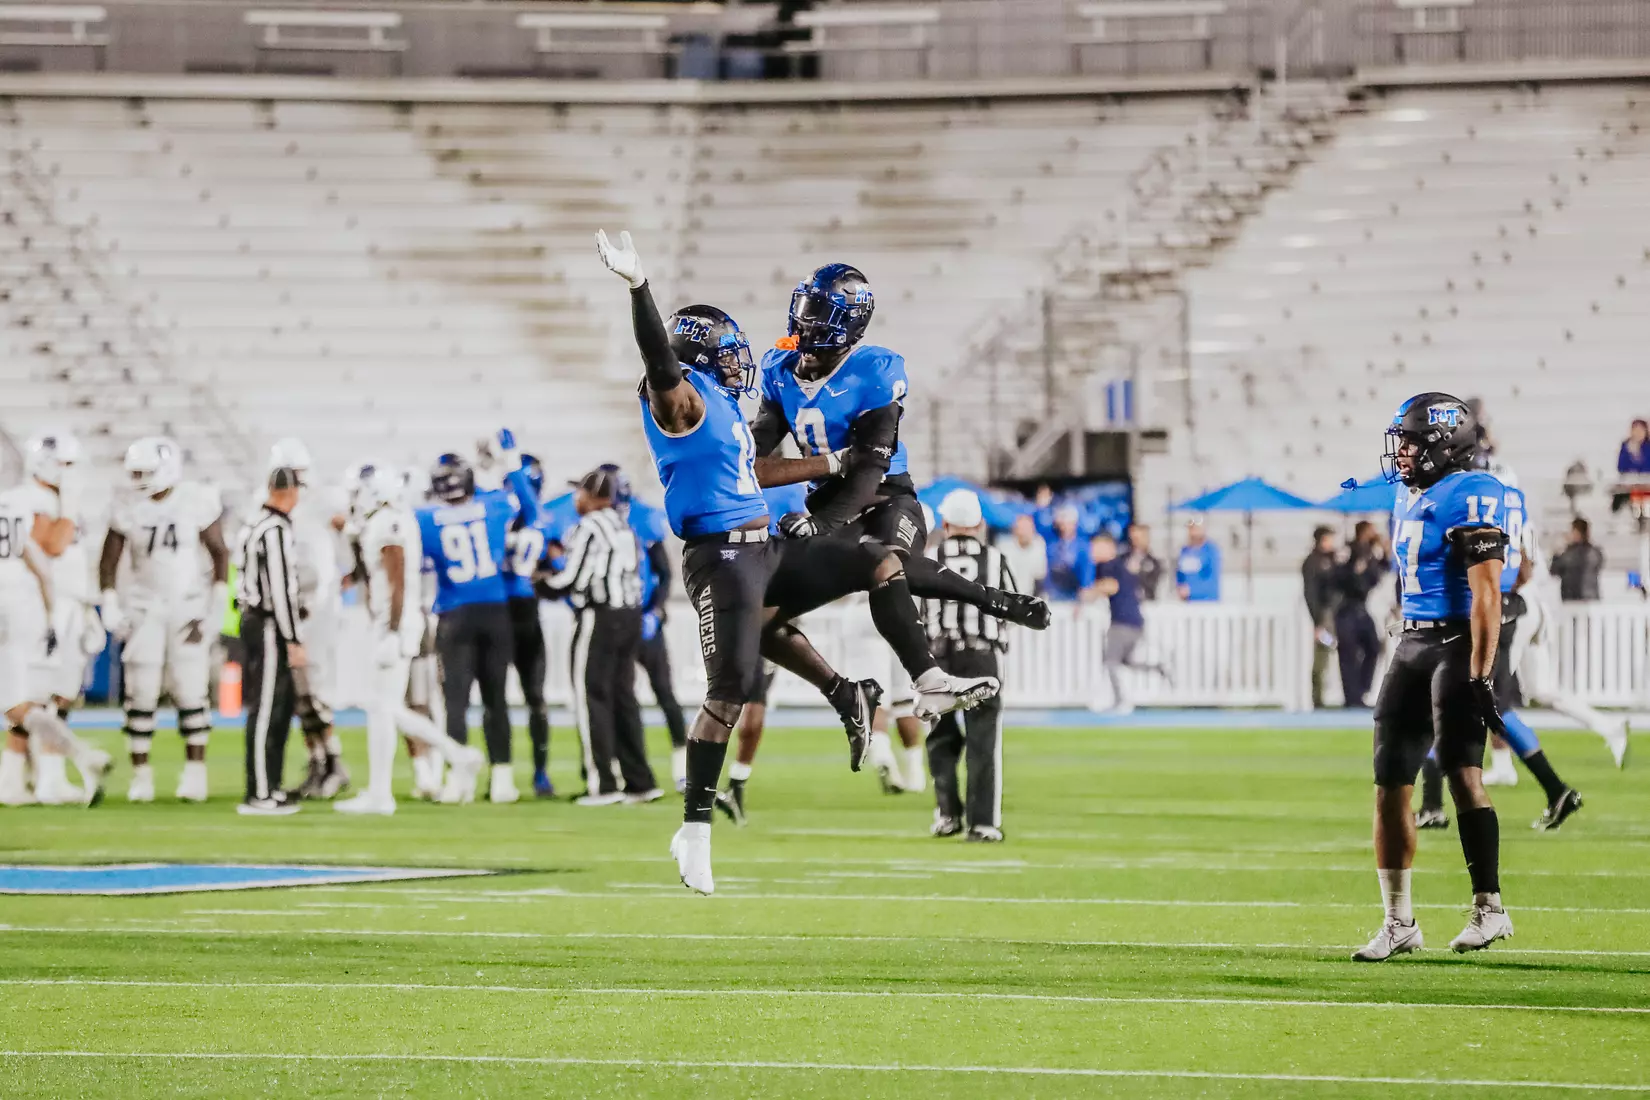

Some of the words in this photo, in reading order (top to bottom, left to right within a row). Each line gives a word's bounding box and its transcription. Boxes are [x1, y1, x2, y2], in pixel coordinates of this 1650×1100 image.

[674, 317, 712, 343] MT
[1427, 406, 1460, 427] MT
[731, 421, 763, 495] 1
[1466, 495, 1498, 523] 17
[142, 523, 178, 556] 74
[440, 520, 498, 584] 91
[699, 584, 716, 657] RAIDERS
